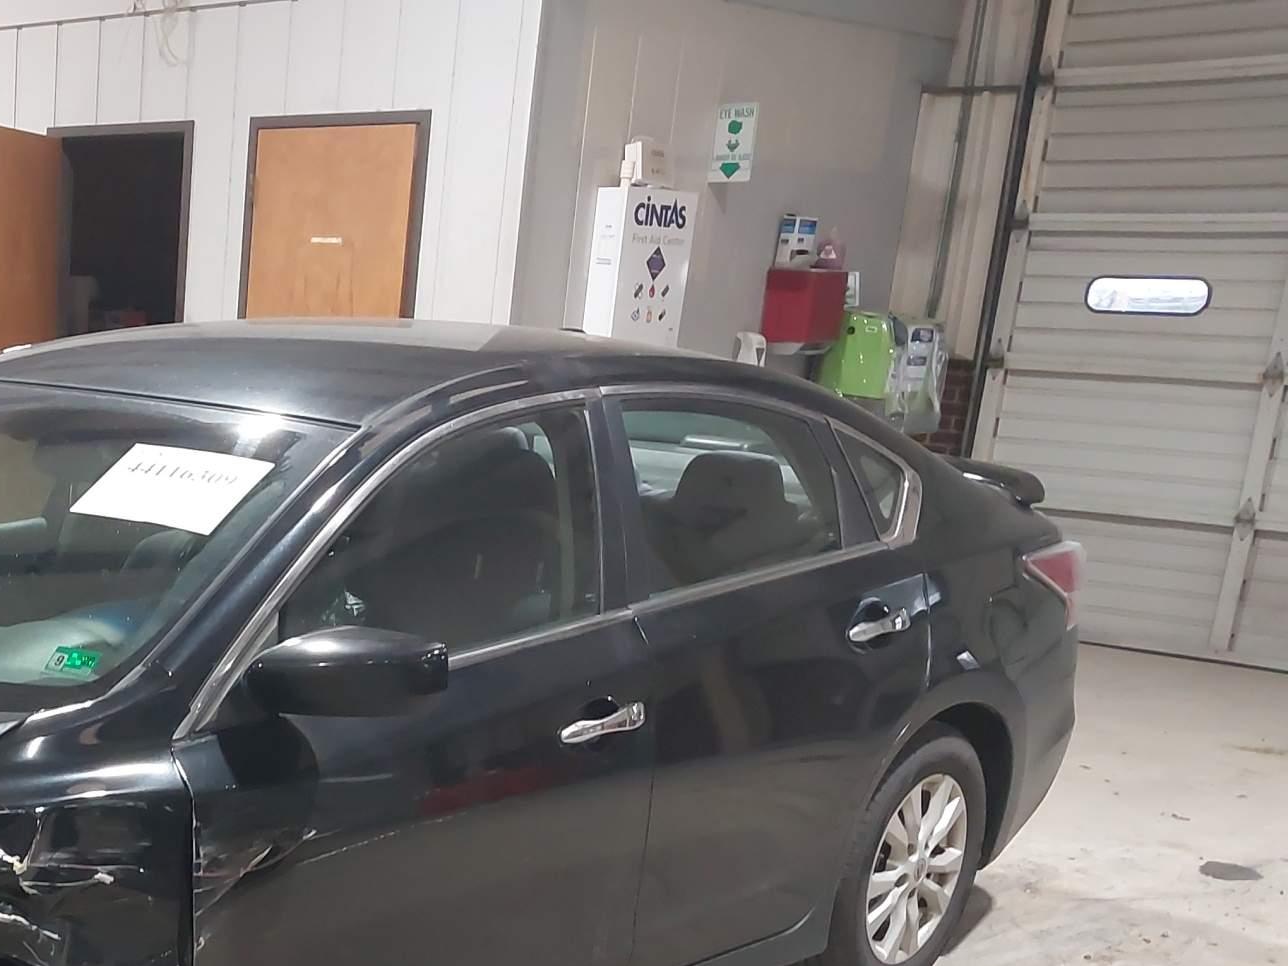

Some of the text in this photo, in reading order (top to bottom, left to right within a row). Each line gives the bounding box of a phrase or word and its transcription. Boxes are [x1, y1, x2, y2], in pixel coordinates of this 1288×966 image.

[719, 107, 755, 120] EYE WASH
[634, 195, 687, 230] CINTAS
[631, 233, 648, 243] First
[648, 235, 661, 244] Aid
